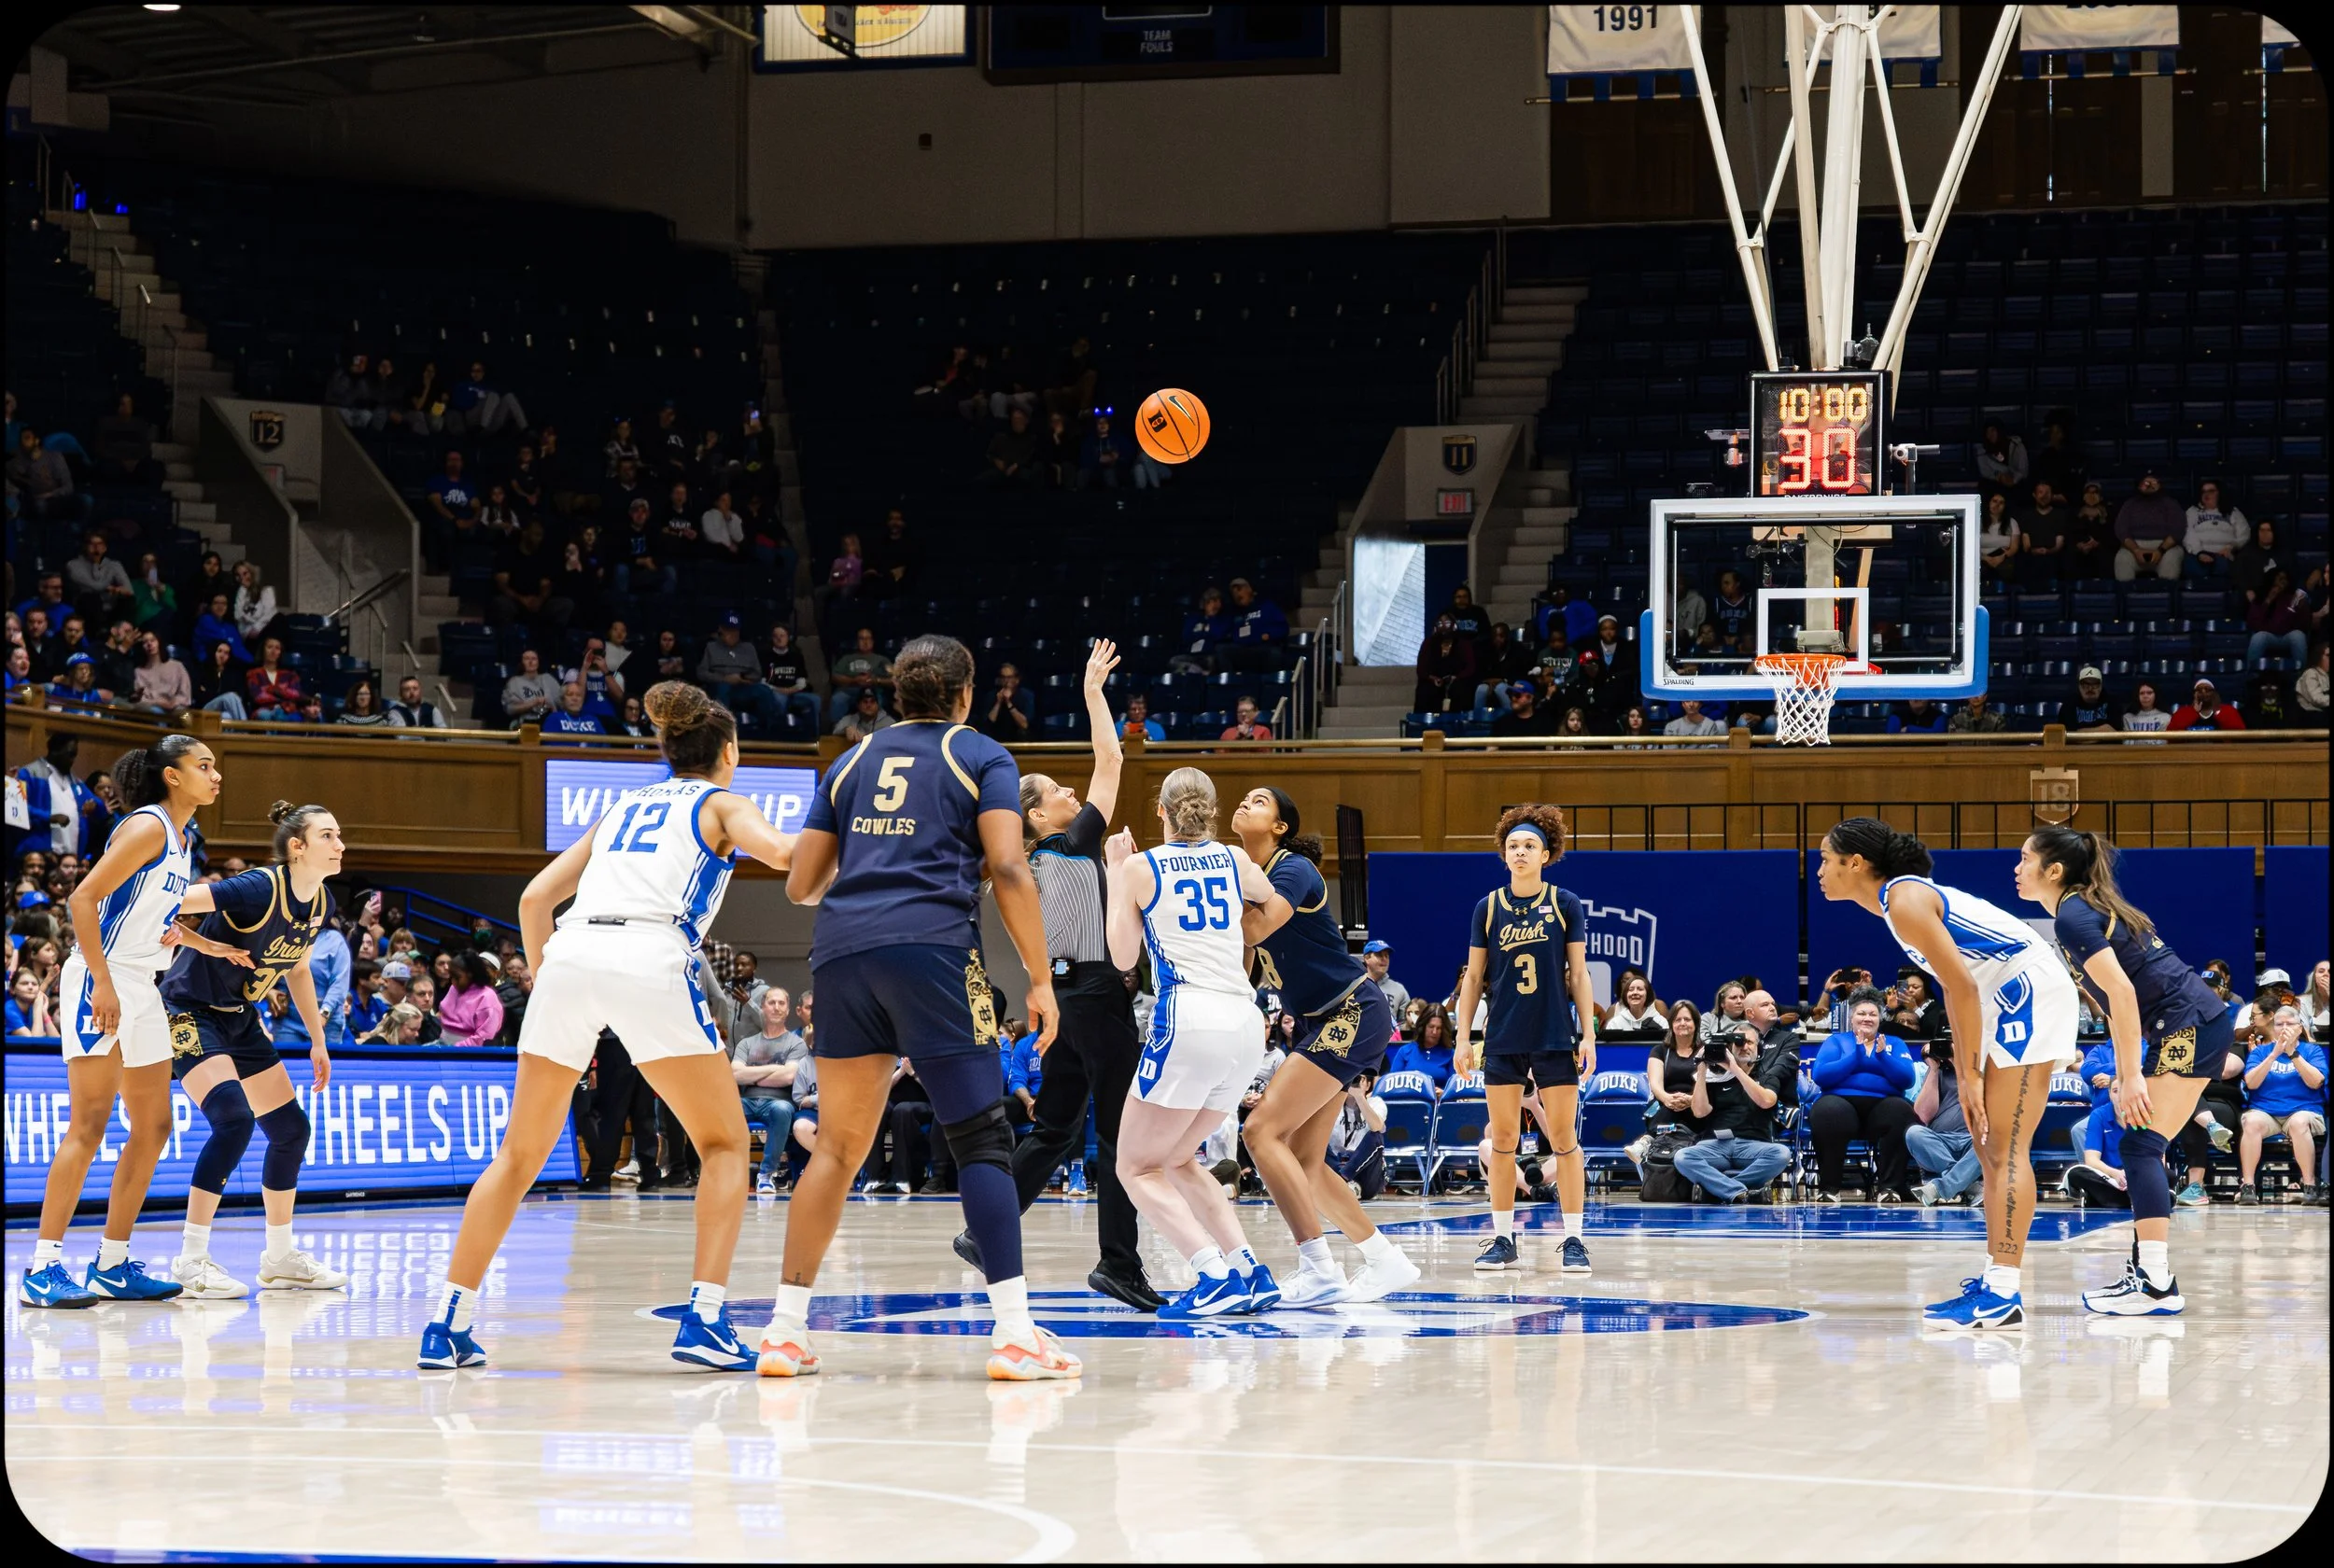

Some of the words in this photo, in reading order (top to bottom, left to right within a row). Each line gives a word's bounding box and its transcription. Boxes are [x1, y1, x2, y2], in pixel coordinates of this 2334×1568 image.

[1593, 6, 1658, 32] 1991
[1143, 30, 1172, 41] TEAM
[1140, 41, 1174, 53] FOULS
[1779, 387, 1867, 423] 10:00
[257, 422, 280, 444] 12
[1450, 446, 1469, 467] 11
[1779, 427, 1856, 490] 30
[1663, 678, 1694, 686] SPALDING
[873, 757, 915, 812] 5
[608, 801, 672, 853] 12
[851, 816, 916, 835] COWLES
[1158, 853, 1232, 875] FOURNIER
[164, 871, 189, 897] DUK
[1174, 876, 1230, 931] 35
[1498, 920, 1547, 948] Irish
[1514, 953, 1539, 995] 3
[2002, 1020, 2027, 1043] D
[1139, 1057, 1158, 1080] D
[1384, 1073, 1424, 1093] DUKE
[1455, 1073, 1485, 1093] DUK
[1598, 1074, 1638, 1094] DUKE
[2048, 1075, 2083, 1096] UKE
[296, 1085, 452, 1166] WHEELS
[461, 1085, 510, 1161] UP
[1998, 1241, 2018, 1255] 222
